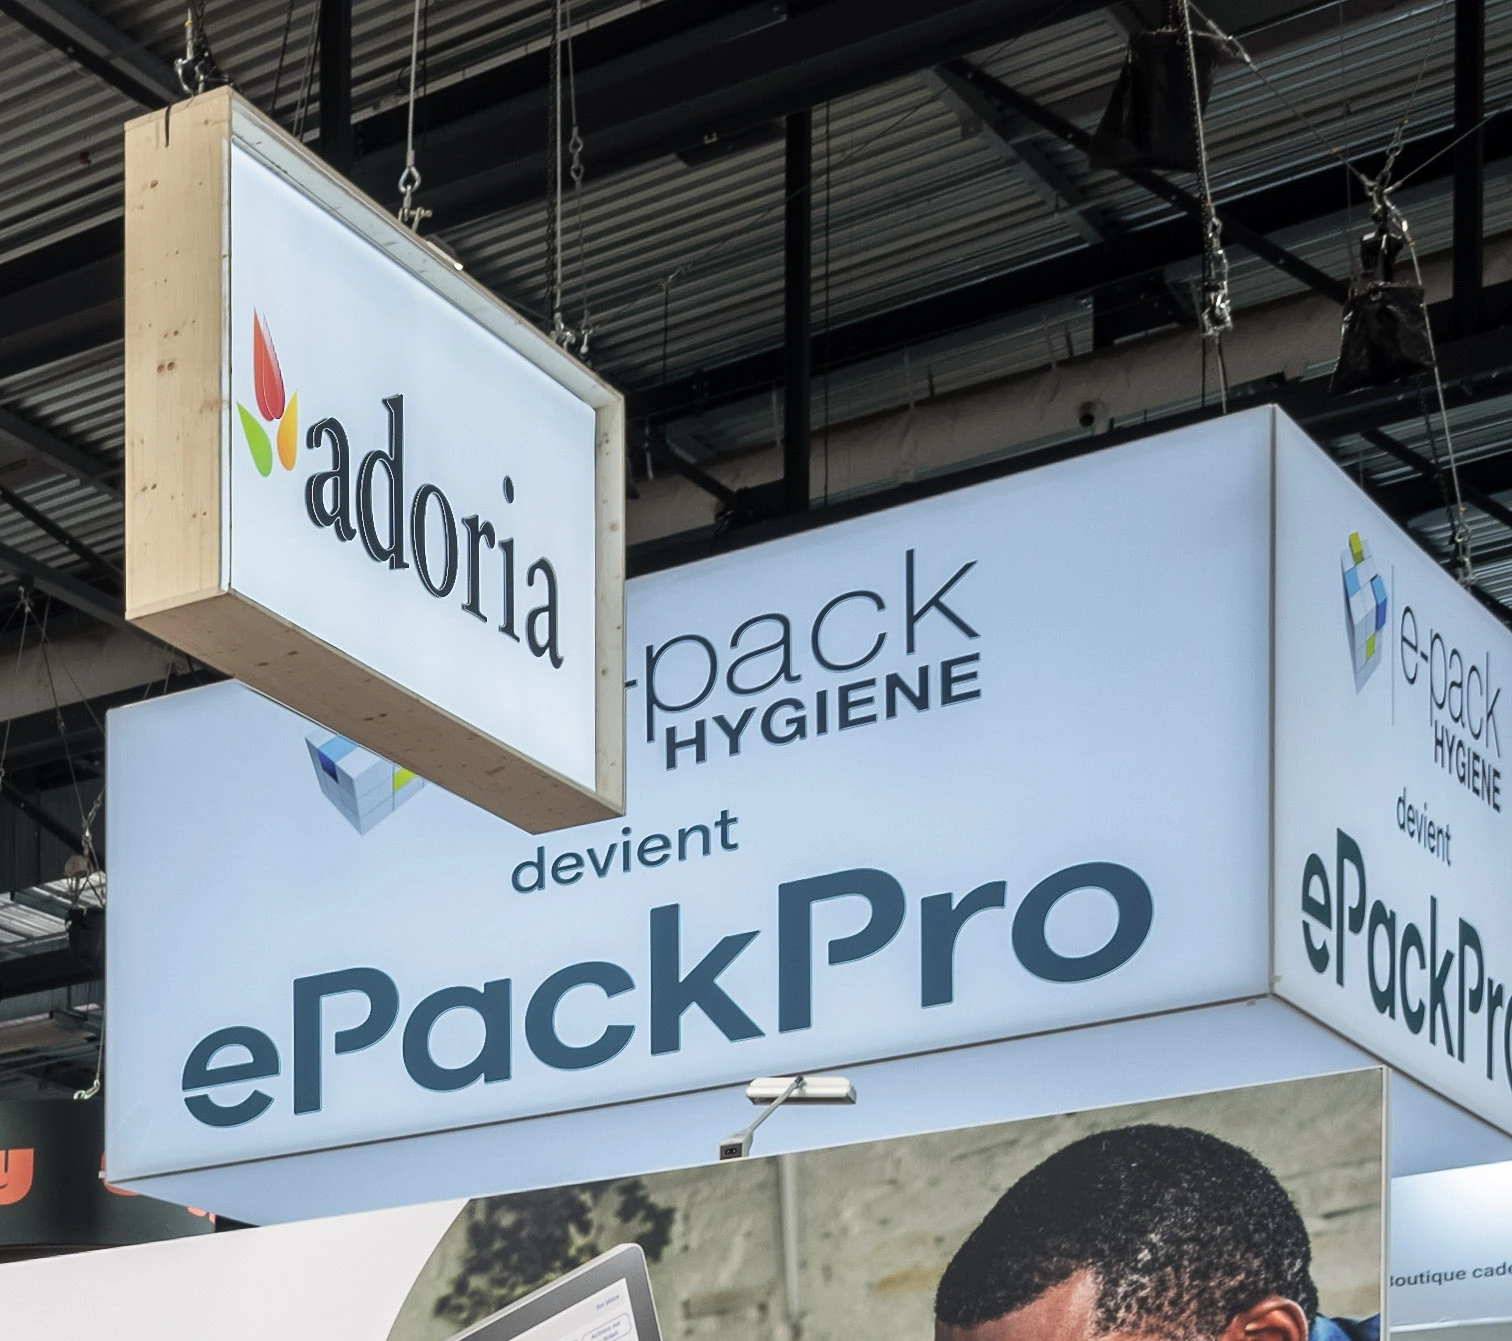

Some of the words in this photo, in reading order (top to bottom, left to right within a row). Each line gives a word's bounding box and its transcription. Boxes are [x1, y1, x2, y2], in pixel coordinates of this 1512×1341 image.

[305, 394, 565, 671] adoria
[666, 652, 984, 772] HYGIENE
[1400, 605, 1502, 758] e-pack
[1396, 785, 1453, 867] devient
[1433, 718, 1502, 814] HYGIENE
[510, 807, 741, 894] devient
[181, 860, 1156, 1128] ePackPro
